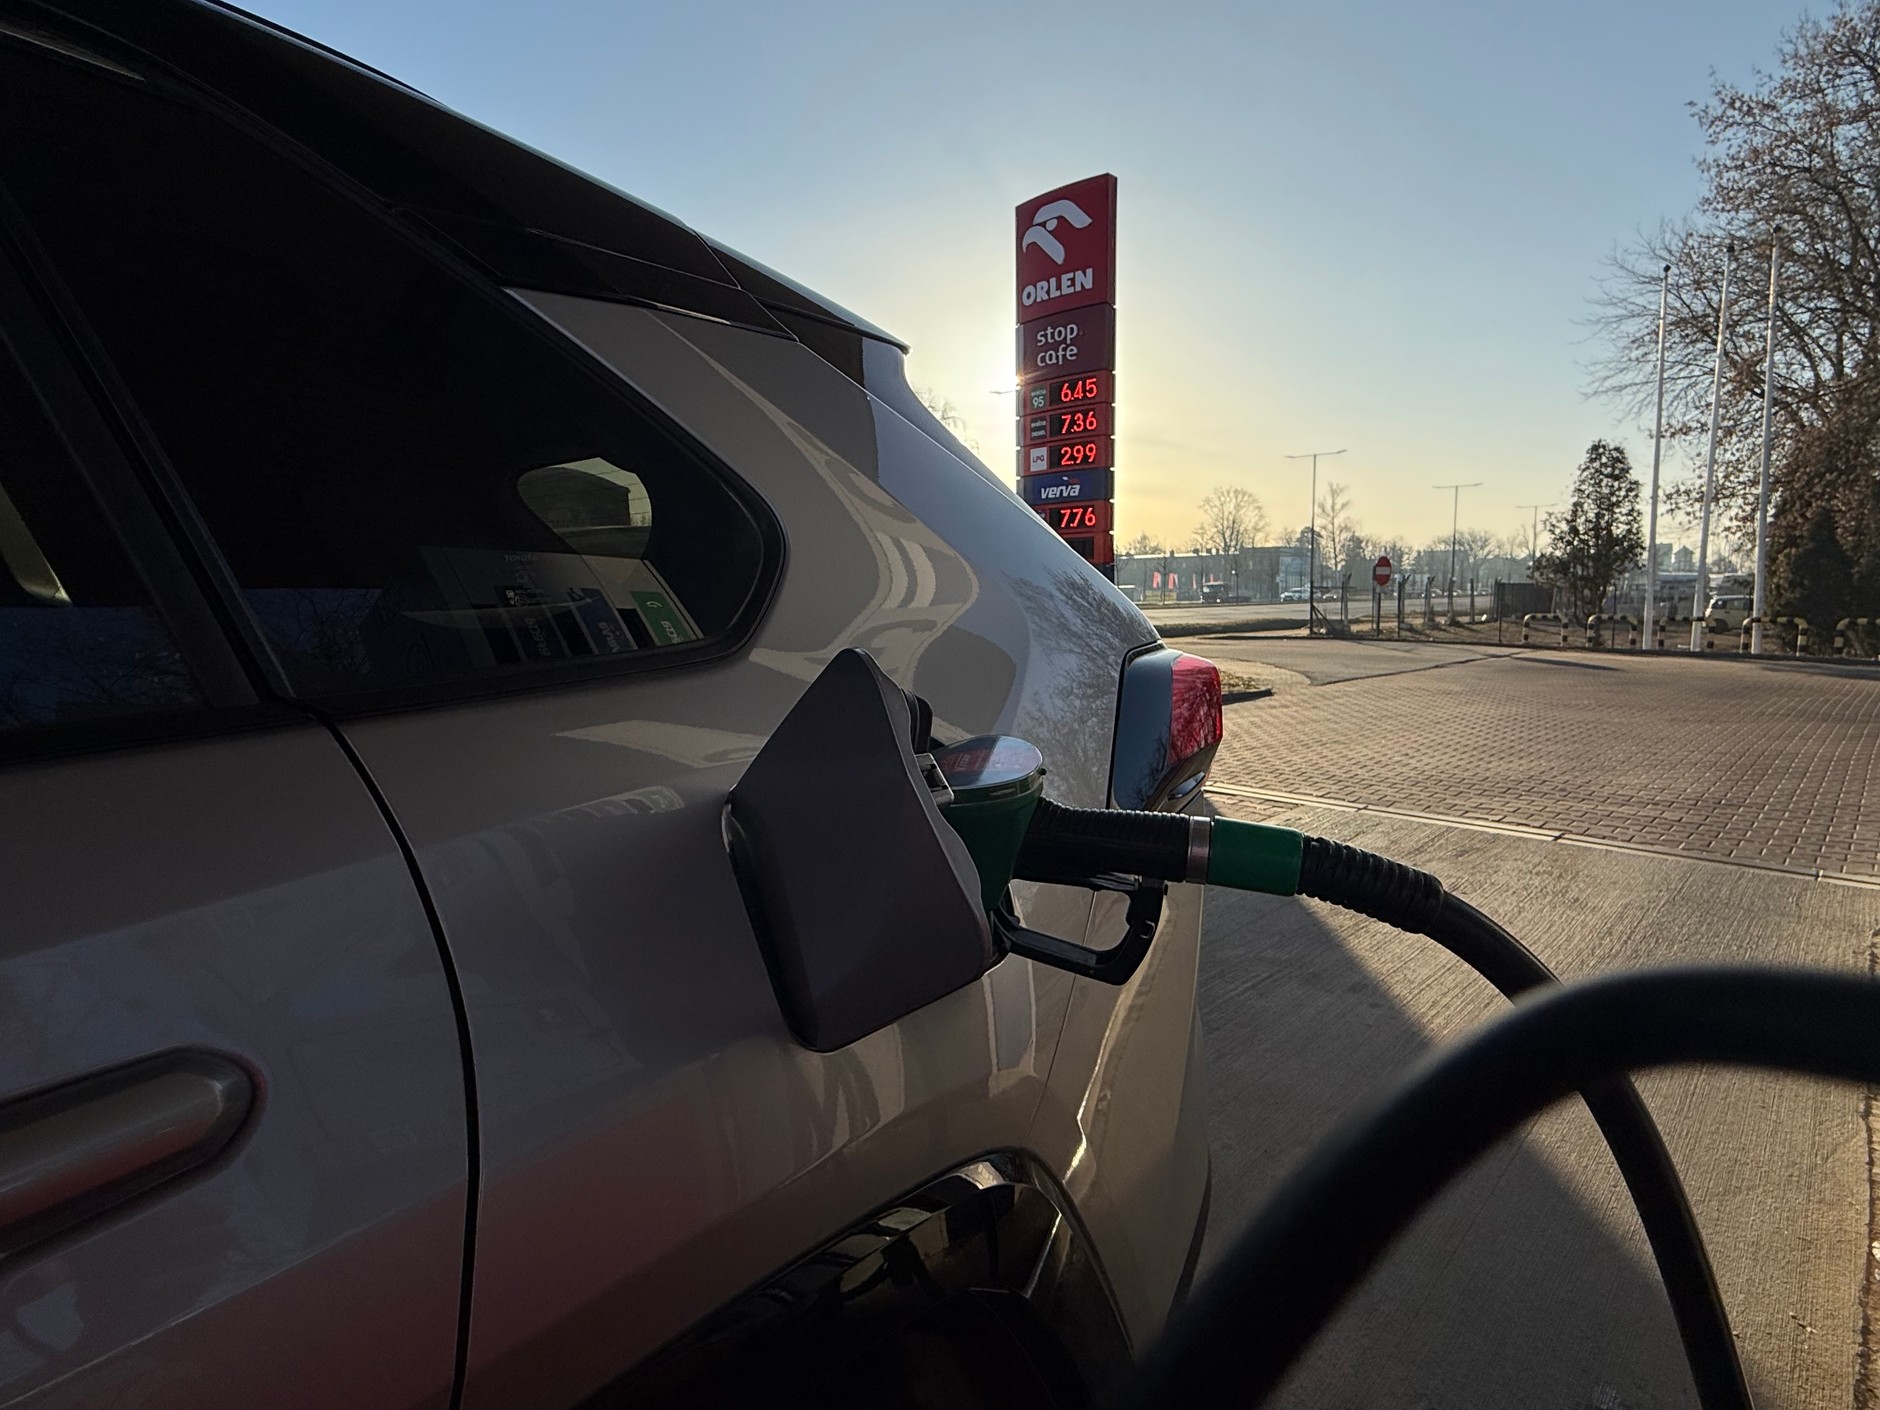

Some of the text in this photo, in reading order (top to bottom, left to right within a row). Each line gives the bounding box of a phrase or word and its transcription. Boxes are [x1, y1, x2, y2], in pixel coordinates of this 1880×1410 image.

[1022, 268, 1093, 306] ORLEN
[1037, 324, 1078, 346] stop
[1037, 344, 1078, 366] cafe
[1060, 378, 1098, 402] 6.45
[1032, 396, 1045, 409] 95
[1061, 411, 1097, 434] 7.36
[1032, 454, 1045, 463] LPG
[1060, 443, 1096, 465] 2.99
[1040, 483, 1081, 499] verva
[1060, 507, 1096, 528] 7.76
